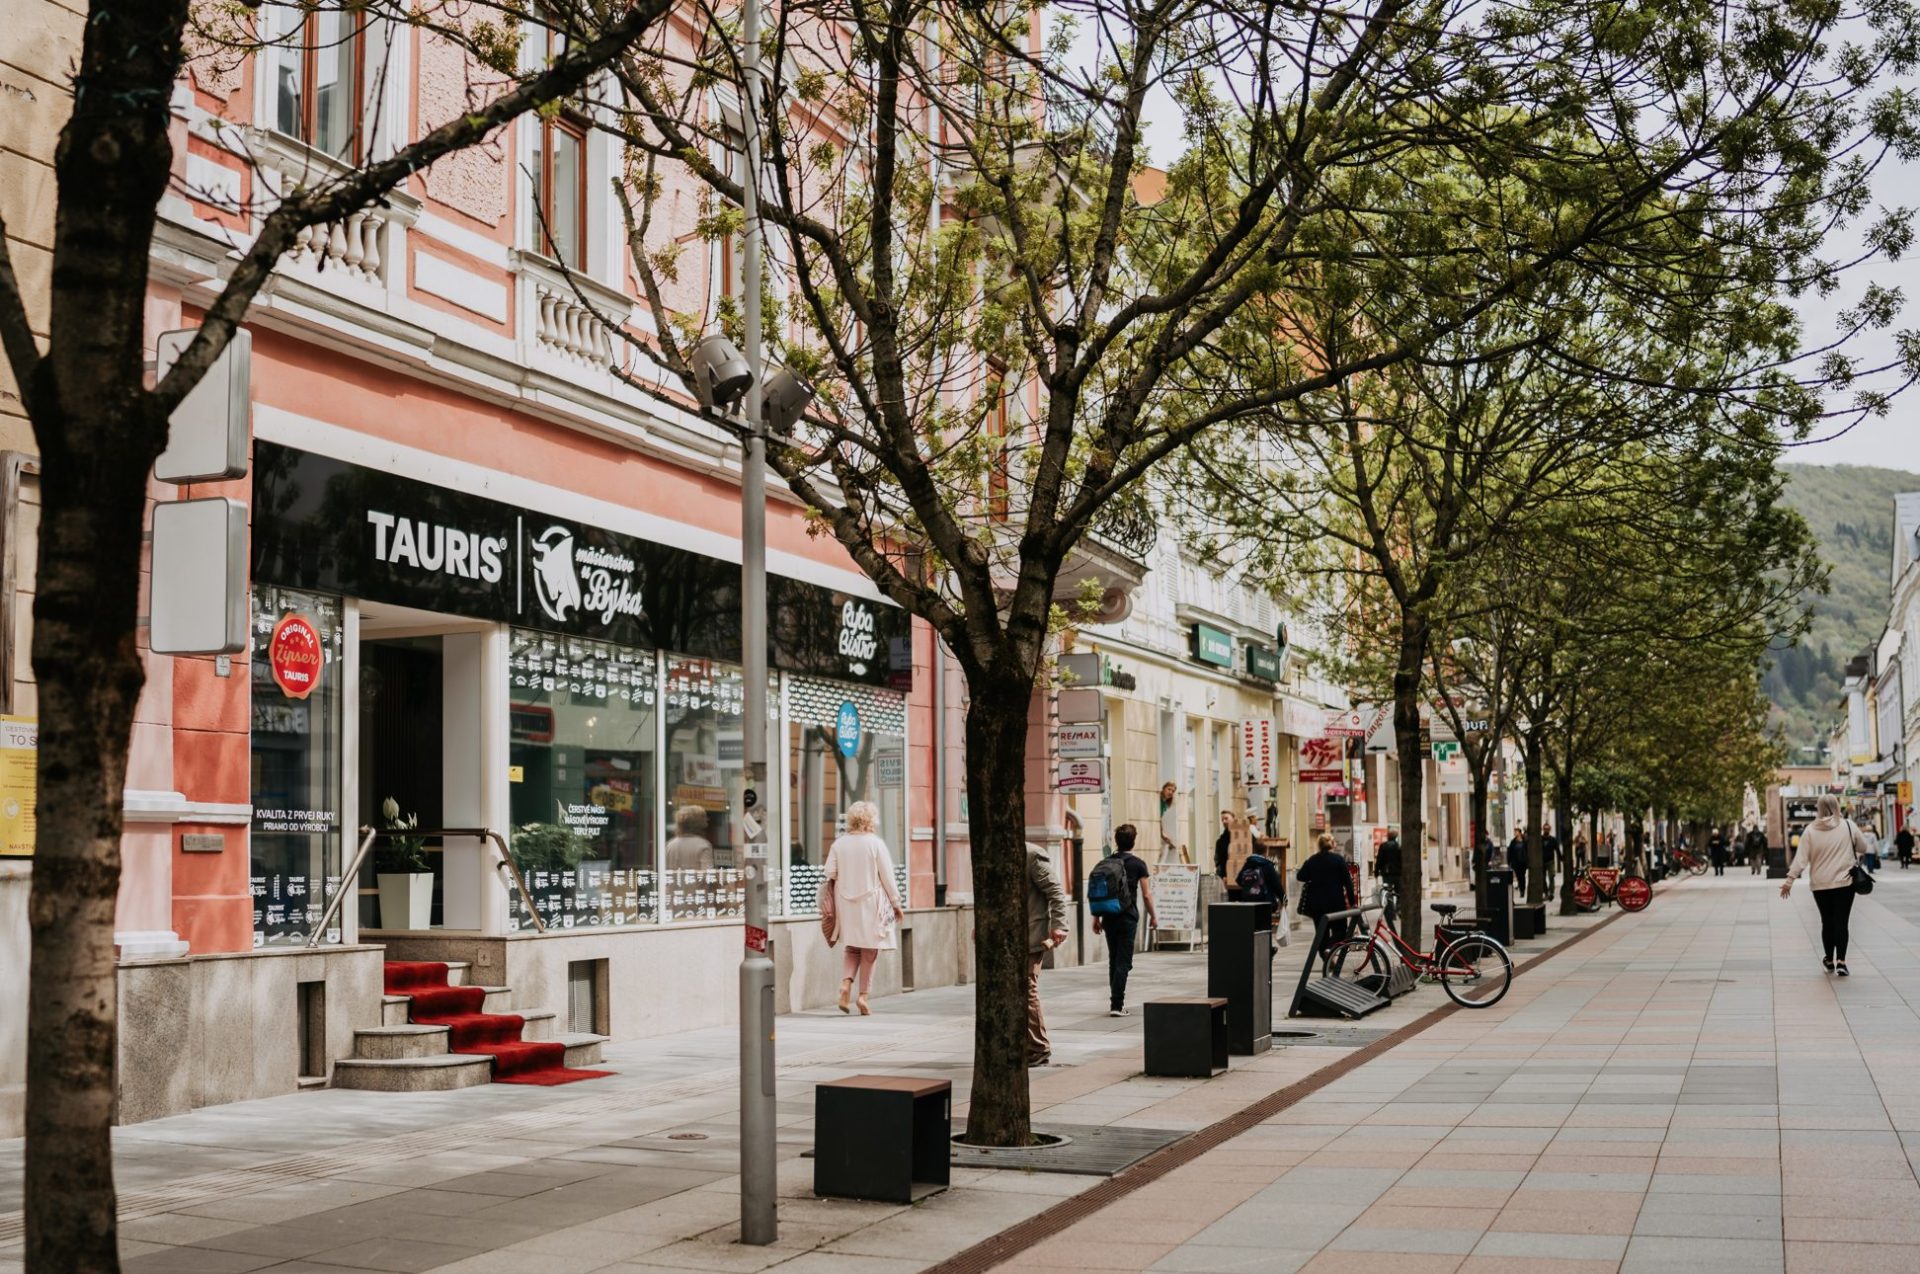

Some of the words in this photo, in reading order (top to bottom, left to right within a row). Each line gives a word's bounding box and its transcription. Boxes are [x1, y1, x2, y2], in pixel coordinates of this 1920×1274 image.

[584, 568, 643, 625] Býka
[842, 600, 874, 635] Ryba
[280, 623, 315, 649] ORIGINAL
[839, 628, 877, 660] Bistro
[276, 644, 319, 666] Zipser
[283, 670, 309, 683] TAURIS
[10, 735, 26, 745] TO
[1060, 731, 1096, 741] RE/MAX
[568, 803, 590, 813] ČERSTVÉ
[256, 809, 286, 819] KVALITA
[288, 810, 293, 820] Z
[294, 810, 315, 820] PRVEJ
[316, 811, 336, 821] RUKY
[263, 822, 288, 831] PRIAMO
[289, 822, 299, 831] OD
[299, 821, 329, 832] VÝROBCU
[588, 827, 601, 836] PULT
